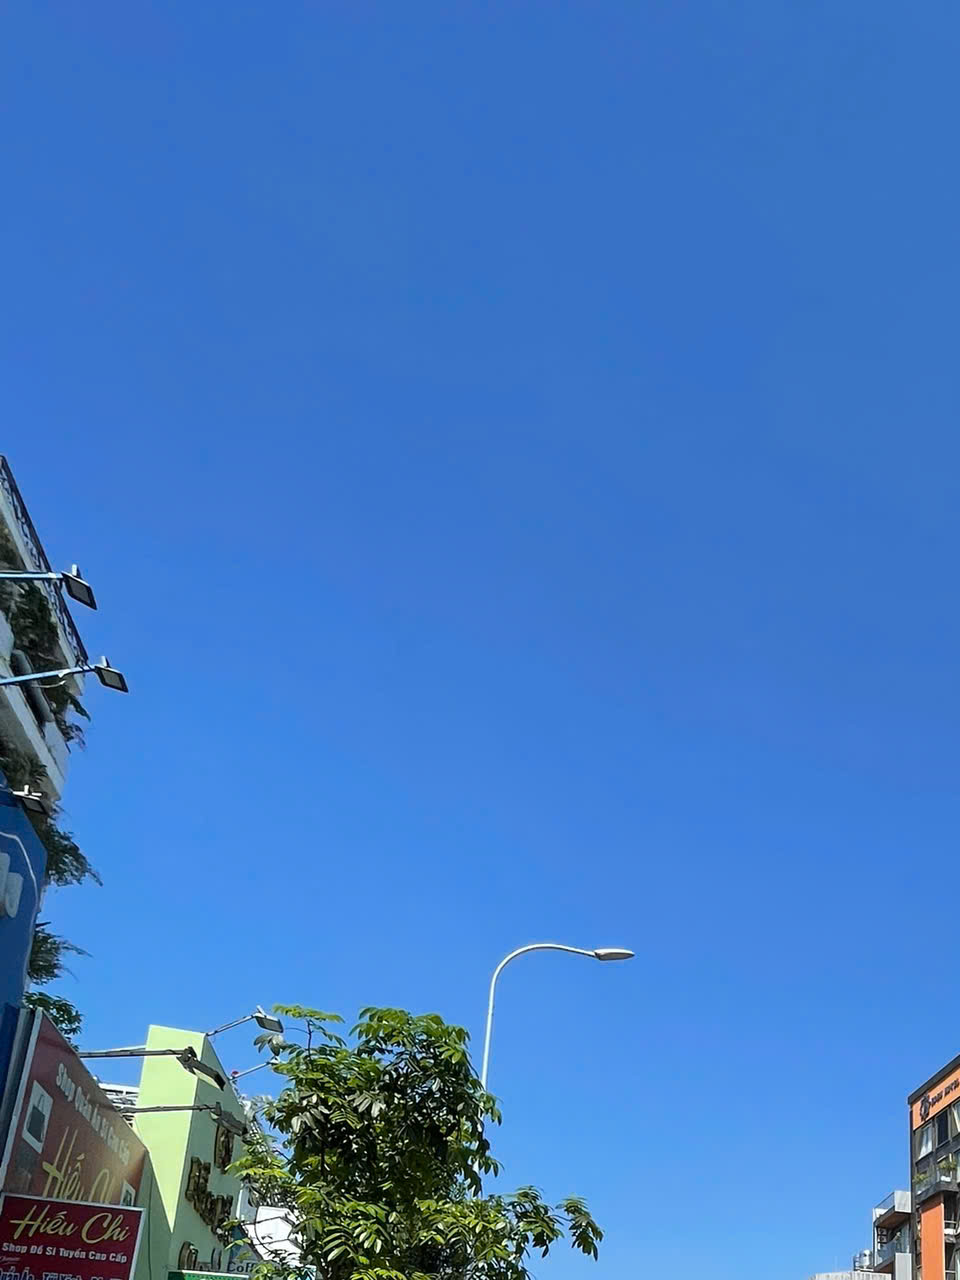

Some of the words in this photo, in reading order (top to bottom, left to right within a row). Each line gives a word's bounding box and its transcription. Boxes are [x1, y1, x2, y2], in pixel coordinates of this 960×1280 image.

[9, 1204, 78, 1240] Hiếu
[81, 1212, 130, 1244] Chi
[2, 1242, 28, 1253] Shop
